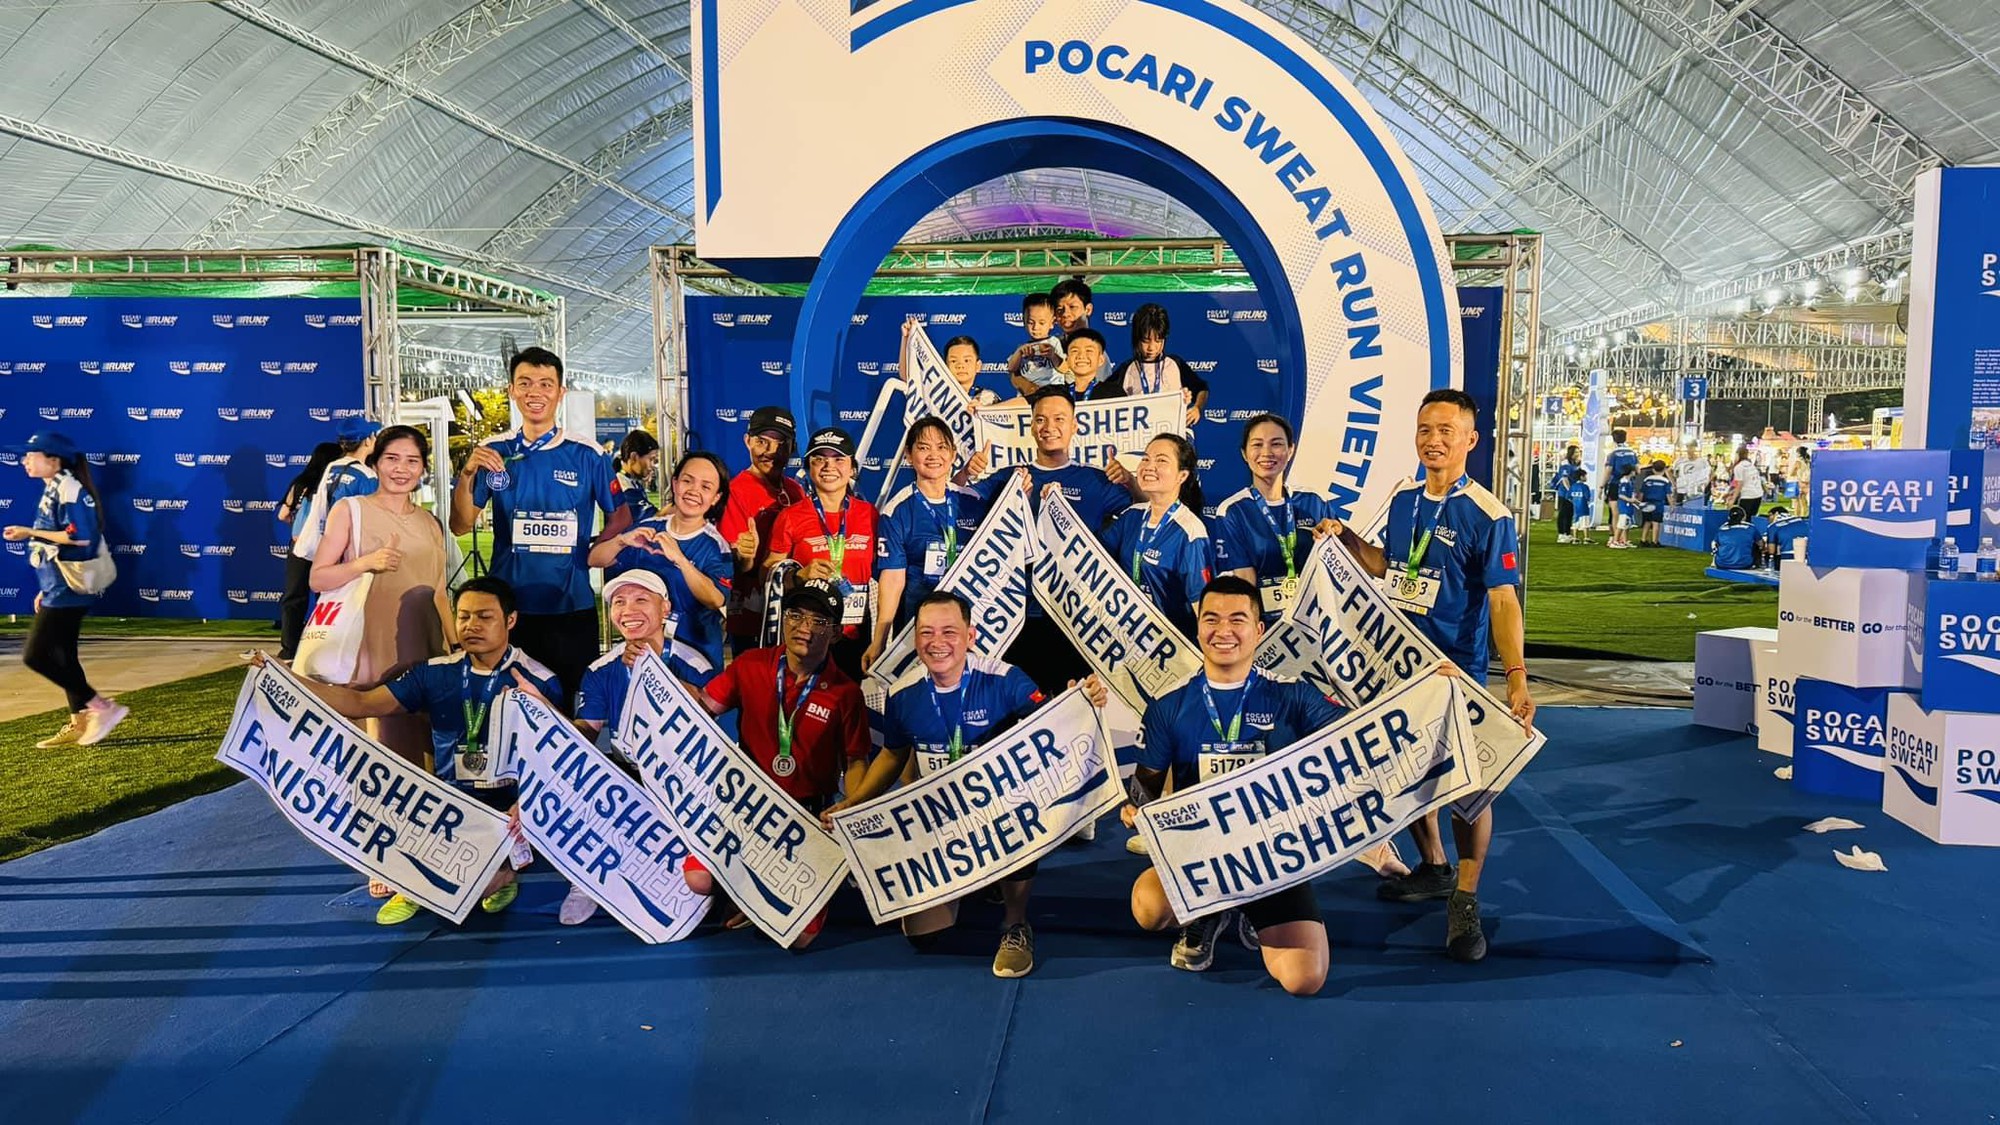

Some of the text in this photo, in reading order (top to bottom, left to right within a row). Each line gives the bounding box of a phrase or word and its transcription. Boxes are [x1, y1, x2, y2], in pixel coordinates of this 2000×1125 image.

[1025, 39, 1384, 522] POCARI SWEAT RUN VIETN
[1689, 383, 1700, 396] 3
[923, 365, 976, 452] FINISH
[1017, 405, 1149, 437] FSHER
[1550, 401, 1558, 412] 4
[990, 443, 1117, 468] FINHER
[1821, 479, 1934, 497] POCARI
[1820, 496, 1923, 514] SWEAT
[523, 523, 568, 537] 50698
[1326, 546, 1352, 581] POCARI
[805, 579, 830, 593] BNI
[1391, 575, 1428, 595] 513
[1032, 541, 1126, 672] INISHER
[1063, 533, 1177, 671] FINISHER
[1341, 585, 1432, 681] FINIS
[1780, 611, 1795, 622] GO
[1813, 616, 1856, 633] BETTER
[1861, 622, 1883, 634] GO
[1940, 614, 2000, 633] POC
[260, 681, 293, 711] SWEAT
[263, 673, 300, 709] POCARI
[641, 673, 668, 705] SWEAT
[644, 666, 673, 703] POCARI
[1697, 676, 1714, 686] GO
[808, 703, 831, 719] BNI
[1807, 709, 1882, 731] POCA
[1806, 724, 1886, 747] SWEA
[1891, 726, 1938, 762] POCARI
[929, 756, 951, 771] 517
[1208, 708, 1419, 835] FINISHER
[1210, 758, 1253, 774] 5178
[1890, 745, 1934, 776] SWEAT
[289, 709, 465, 843] FINISHER
[632, 714, 742, 868] FINSHER
[659, 706, 806, 862] FINISHER
[890, 728, 1065, 842] FINISHER
[239, 720, 398, 863] FINISHER
[535, 724, 693, 873] FINISHER
[508, 732, 621, 885] NISHER
[847, 813, 885, 831] POCARI
[1152, 802, 1201, 822] POCARI
[1155, 811, 1200, 830] SWEAT
[850, 820, 884, 838] SWEAT
[1182, 790, 1395, 898] FINISHER
[874, 802, 1048, 902] FINISHER
